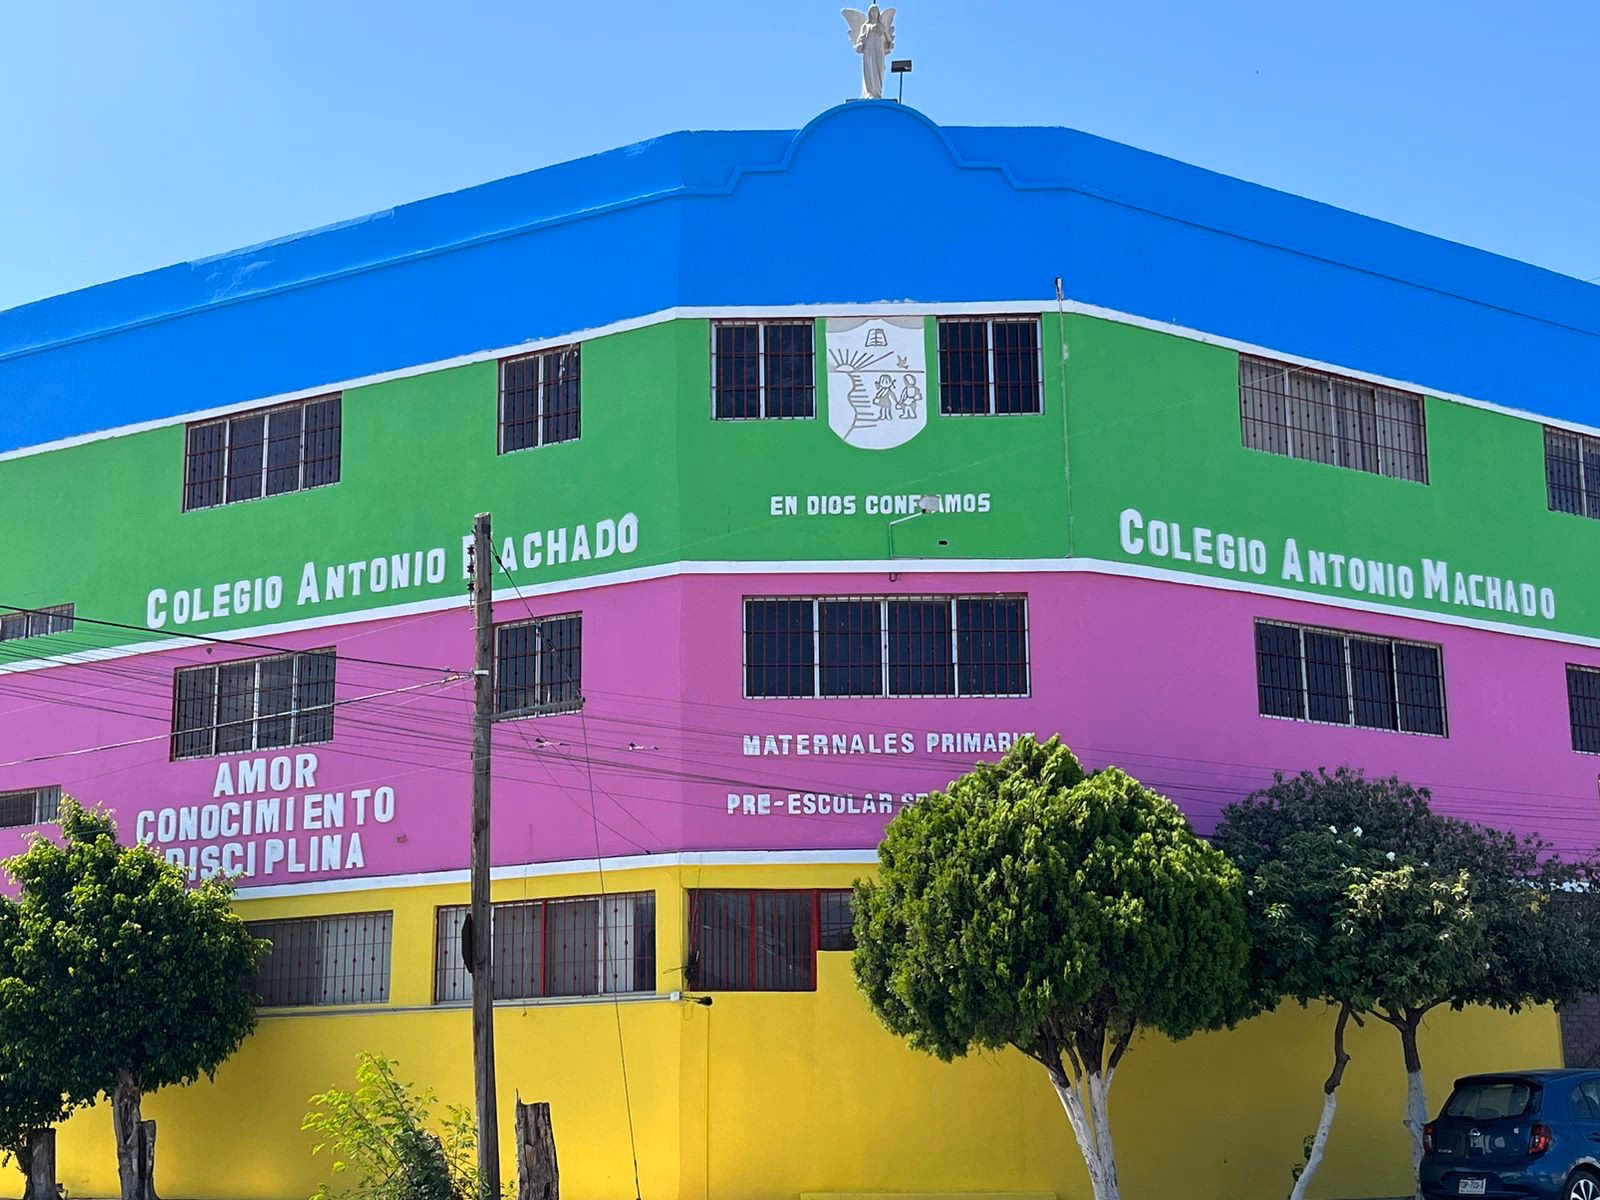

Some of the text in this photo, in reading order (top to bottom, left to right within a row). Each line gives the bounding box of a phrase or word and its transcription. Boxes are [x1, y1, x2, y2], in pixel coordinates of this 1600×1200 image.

[770, 493, 991, 516] EN DIOS CONFAMOS
[1119, 507, 1556, 620] COLEGIO ANTONIO MACHADO
[146, 574, 284, 630] COLEGIO
[297, 546, 447, 607] ANTONIO
[742, 731, 915, 756] MATERNALES
[212, 753, 319, 798] AMOR
[135, 785, 395, 846] CONOCIMIENTO
[727, 792, 893, 815] PRE-ESCOLAR
